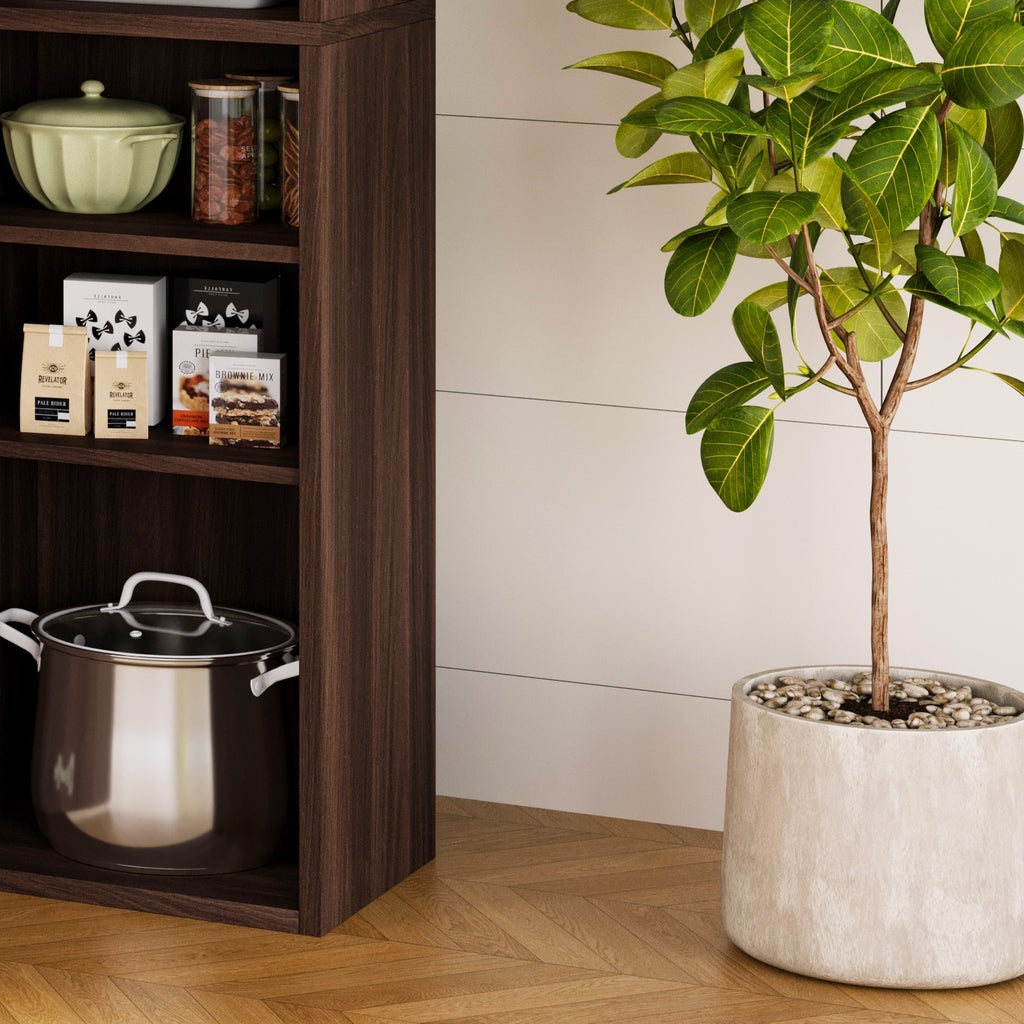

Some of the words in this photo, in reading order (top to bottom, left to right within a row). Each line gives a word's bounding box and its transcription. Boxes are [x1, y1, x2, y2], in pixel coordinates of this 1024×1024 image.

[194, 348, 211, 358] PIE
[38, 375, 68, 386] REVELATOR
[215, 370, 254, 380] BROWNIE
[258, 373, 274, 382] MIX
[109, 391, 134, 399] REVELATOR
